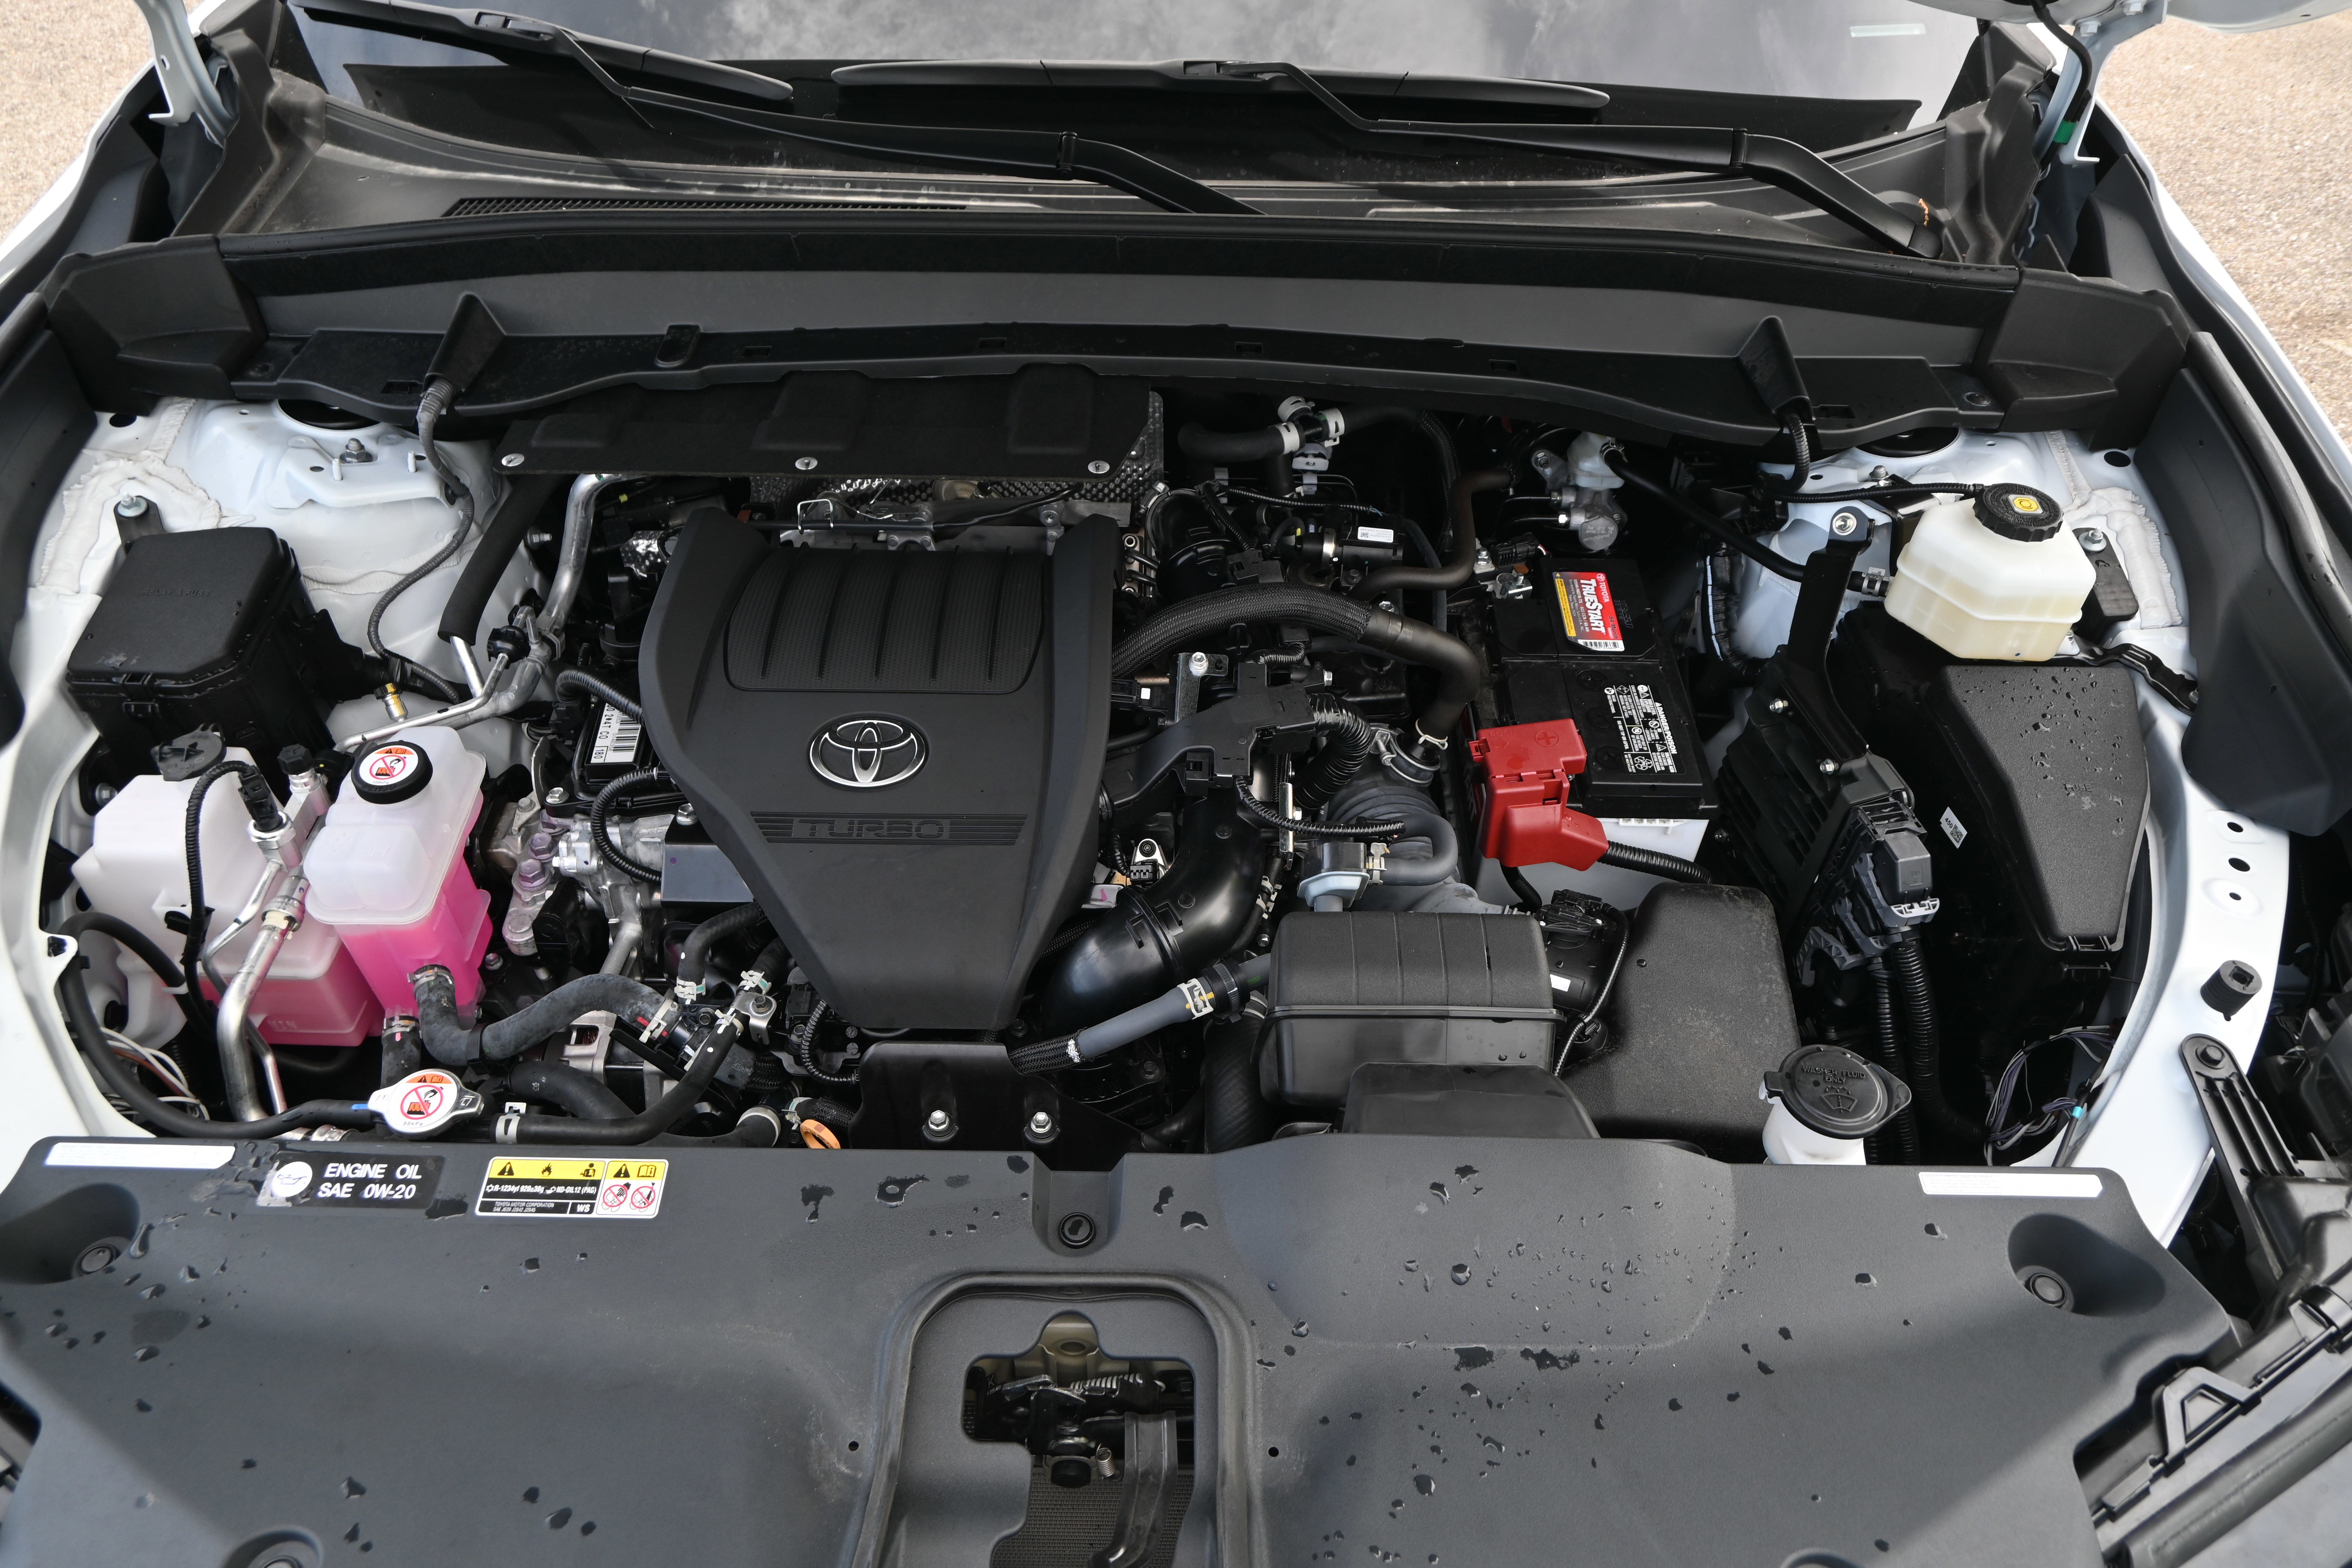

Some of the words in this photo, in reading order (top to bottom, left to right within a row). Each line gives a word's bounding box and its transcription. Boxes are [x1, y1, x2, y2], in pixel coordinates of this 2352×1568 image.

[185, 589, 212, 597] FUSE
[1599, 582, 1609, 602] TOYOTA
[1580, 579, 1606, 633] TRUESTART
[1488, 729, 1516, 737] PUSH
[1657, 707, 1677, 754] DANGER/POISON
[593, 749, 604, 758] 180
[2064, 783, 2092, 792] FUSE
[1944, 817, 1953, 828] 450
[799, 819, 945, 839] TURBO
[1802, 1065, 1838, 1075] WASHER
[1842, 1070, 1866, 1078] FLUID
[1825, 1075, 1846, 1083] ONLY
[324, 1163, 388, 1178] ENGINE
[395, 1164, 422, 1179] OIL
[318, 1182, 355, 1198] SAE
[363, 1184, 416, 1199] 0W-20
[494, 1184, 520, 1193] R-1234yf
[581, 1186, 597, 1195] (PAG)
[576, 1204, 591, 1212] WS
